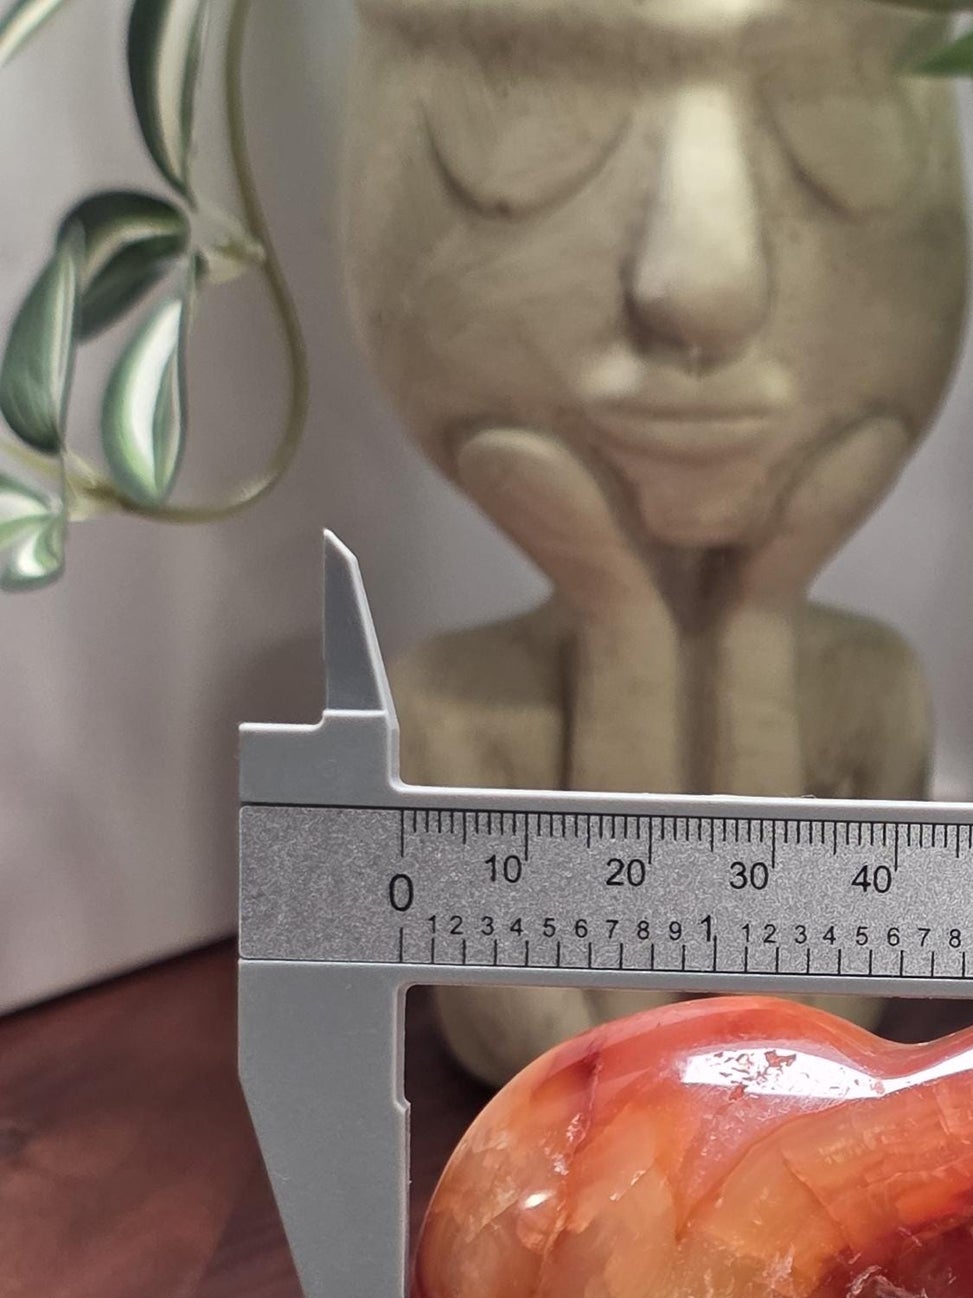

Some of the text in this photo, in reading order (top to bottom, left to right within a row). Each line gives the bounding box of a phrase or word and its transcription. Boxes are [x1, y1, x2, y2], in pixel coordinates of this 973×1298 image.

[389, 874, 413, 912] 0
[485, 855, 522, 883] 10
[606, 858, 646, 887] 20
[730, 861, 769, 890] 30
[850, 865, 892, 893] 40
[428, 915, 437, 934] 1
[450, 915, 463, 935] 2
[481, 916, 494, 935] 3
[510, 918, 523, 936] 4
[543, 918, 556, 938] 5
[574, 919, 588, 938] 6
[606, 919, 618, 939] 7
[637, 921, 649, 940] 8
[669, 921, 682, 941] 9
[700, 915, 713, 942] 1
[742, 923, 750, 942] 1
[763, 924, 776, 943] 2
[794, 925, 807, 944] 3
[823, 926, 836, 945] 4
[856, 926, 868, 946] 5
[887, 927, 900, 946] 6
[918, 928, 931, 947] 7
[949, 929, 961, 948] 8
